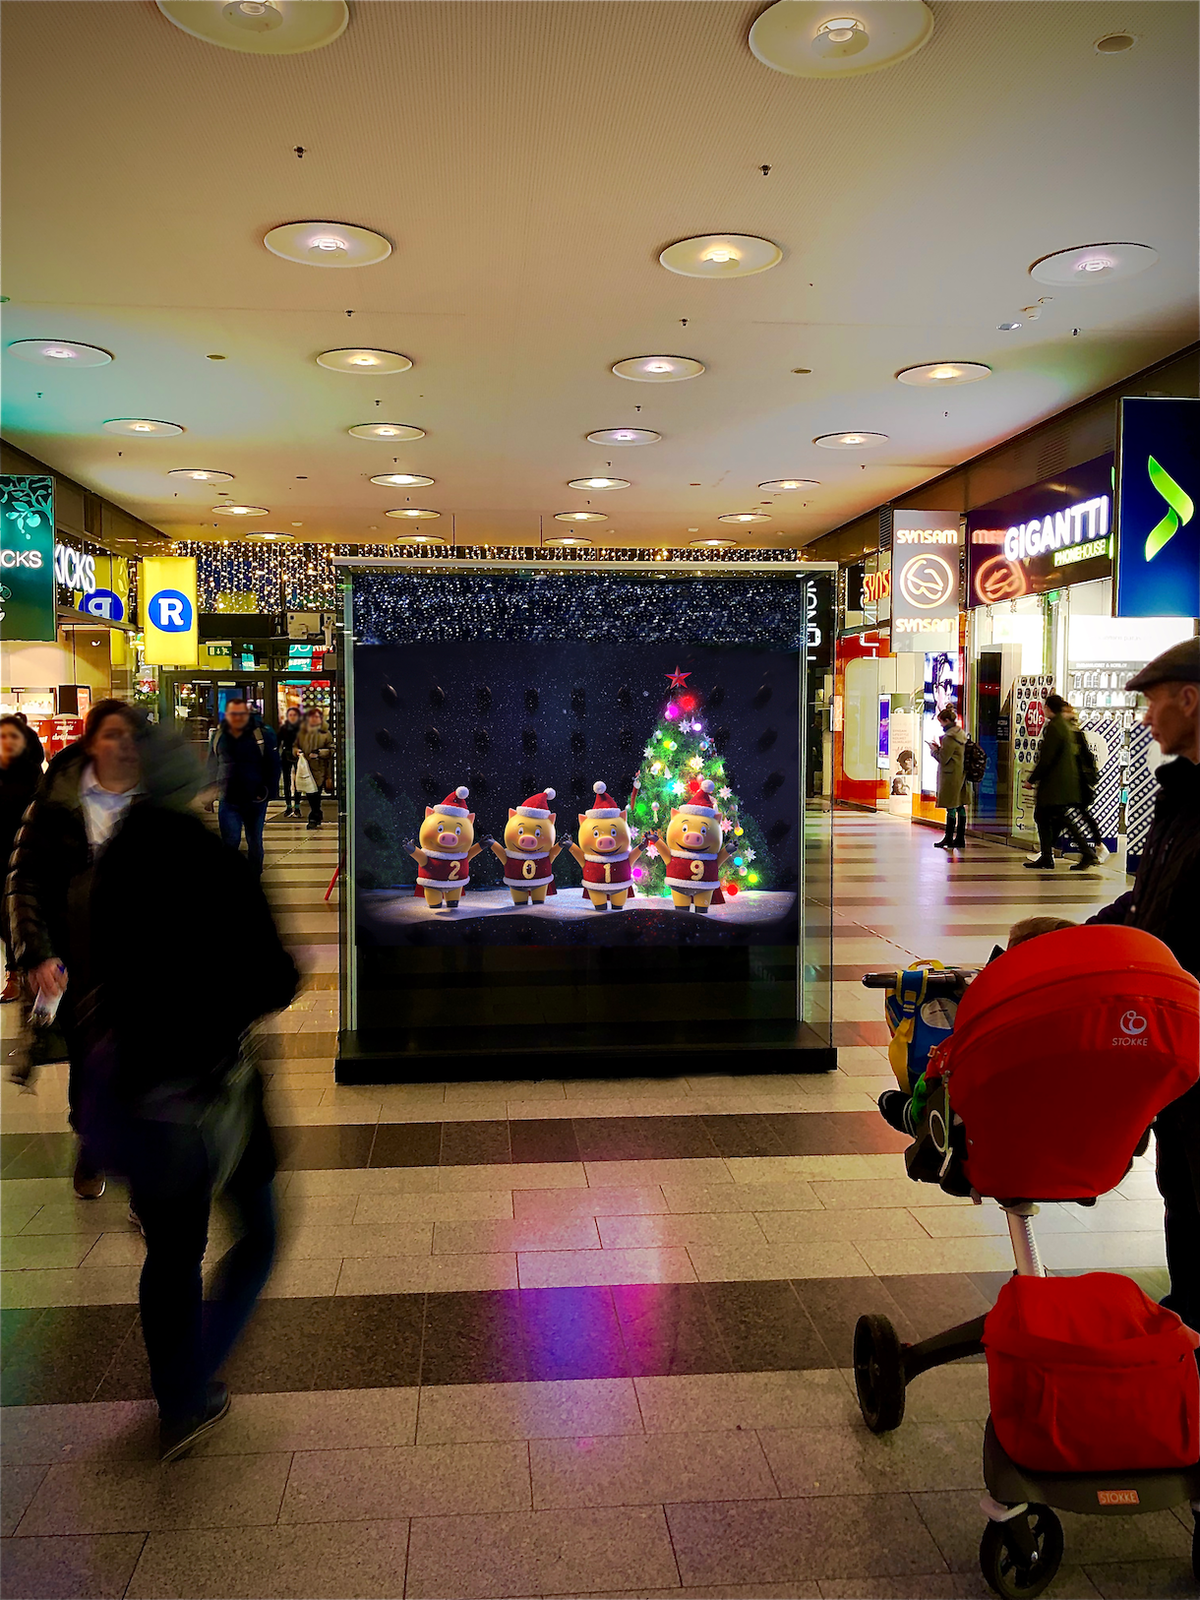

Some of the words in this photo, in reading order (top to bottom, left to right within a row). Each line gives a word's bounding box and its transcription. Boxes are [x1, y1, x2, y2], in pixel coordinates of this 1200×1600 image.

[896, 529, 958, 544] SYNSAM
[1004, 495, 1109, 561] GIGANTTI
[1054, 538, 1106, 567] PHONEHOUSE
[158, 598, 185, 625] R
[895, 618, 957, 633] SYNSAM
[449, 861, 461, 881] 2
[523, 860, 536, 879] 0
[603, 863, 611, 883] 1
[690, 860, 704, 881] 9
[1112, 1036, 1148, 1047] STOKKE
[1100, 1492, 1137, 1503] STOKKE
